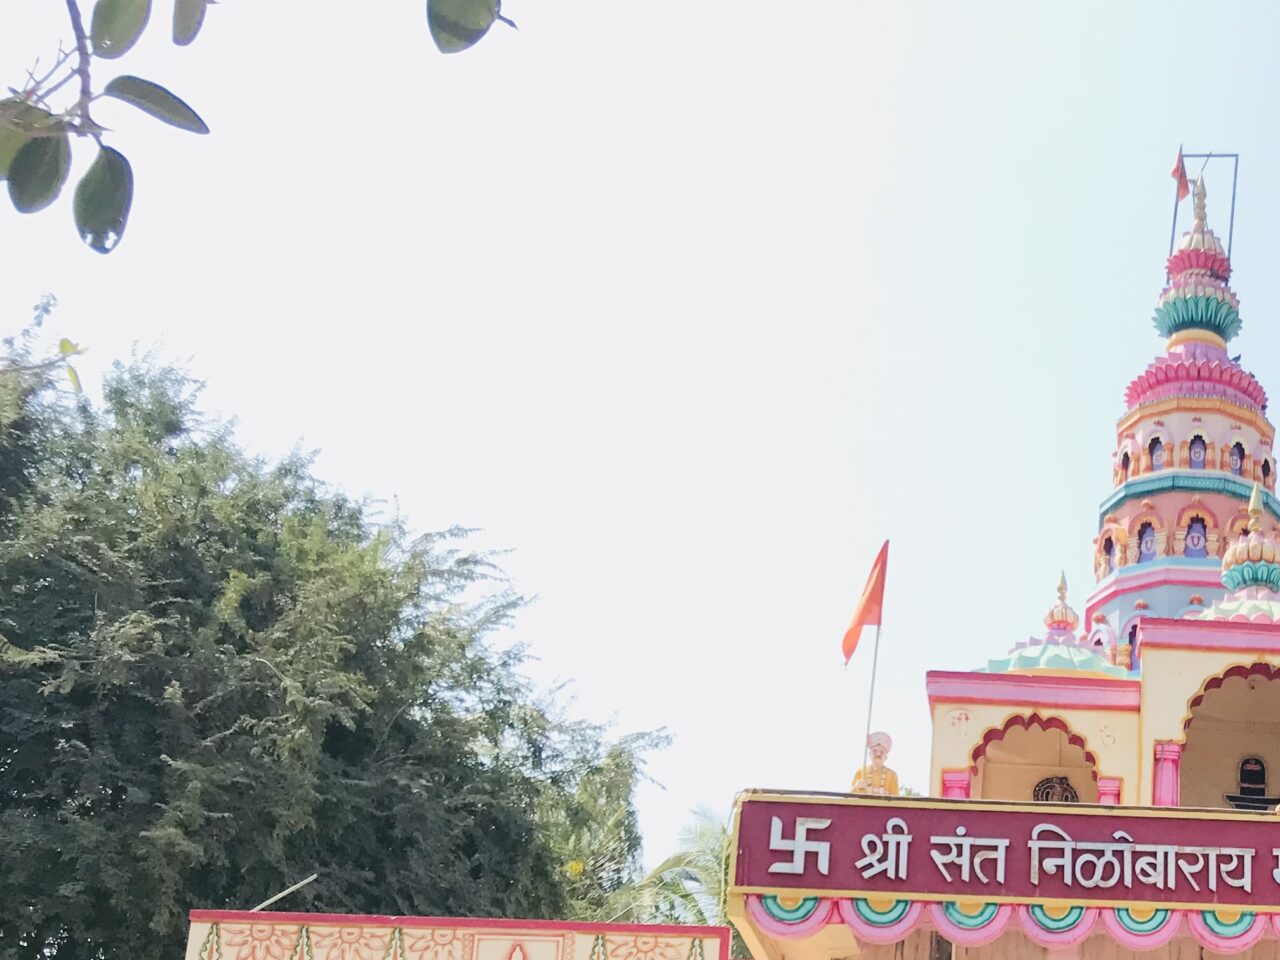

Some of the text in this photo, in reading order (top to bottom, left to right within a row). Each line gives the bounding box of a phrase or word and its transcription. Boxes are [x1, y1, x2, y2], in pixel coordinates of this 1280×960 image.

[854, 816, 914, 880] श्री
[929, 825, 1011, 885] संत
[1027, 822, 1256, 894] निळोबाराय
